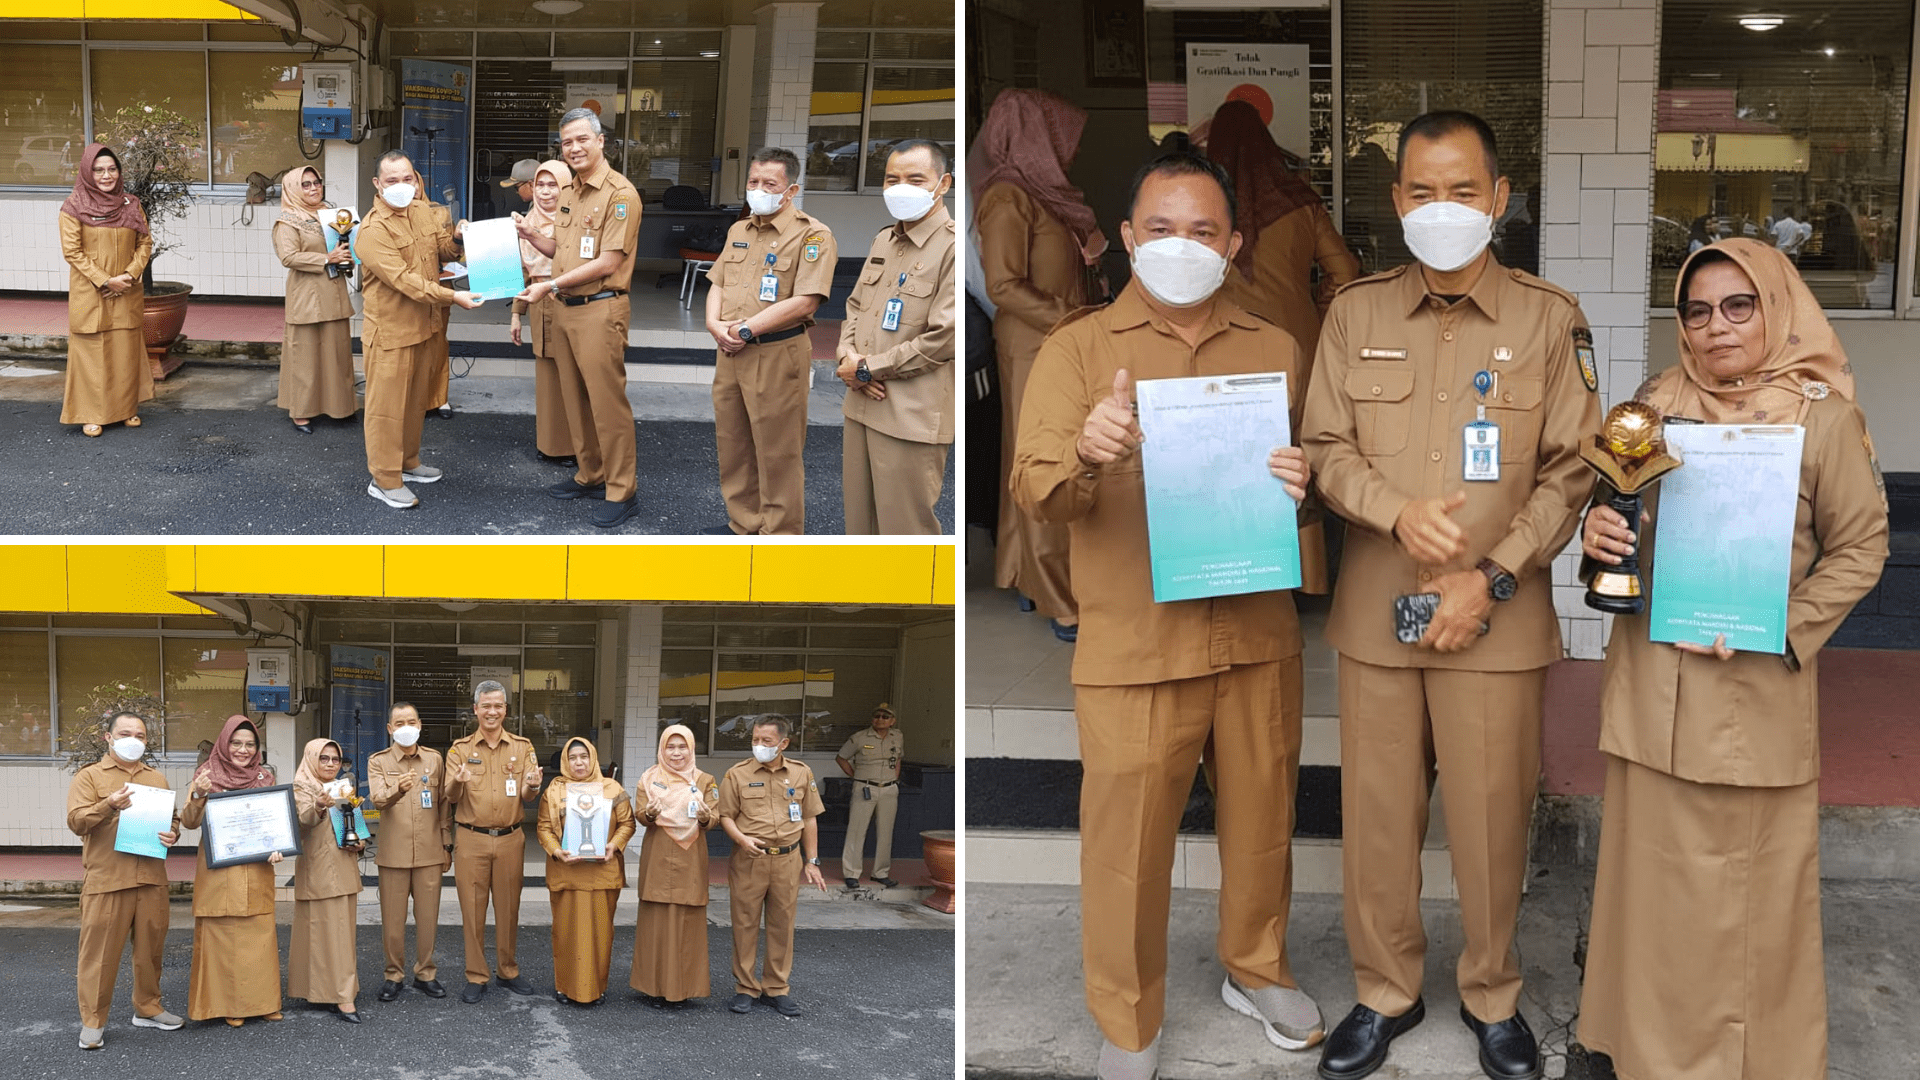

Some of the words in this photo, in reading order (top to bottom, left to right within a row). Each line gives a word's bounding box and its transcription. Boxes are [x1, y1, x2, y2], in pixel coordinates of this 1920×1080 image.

[1235, 52, 1261, 62] Tolak
[1197, 66, 1247, 76] Gratifikasi
[1270, 67, 1300, 78] Pungli
[404, 84, 436, 93] VAKSINASI
[437, 87, 461, 95] COVID-19
